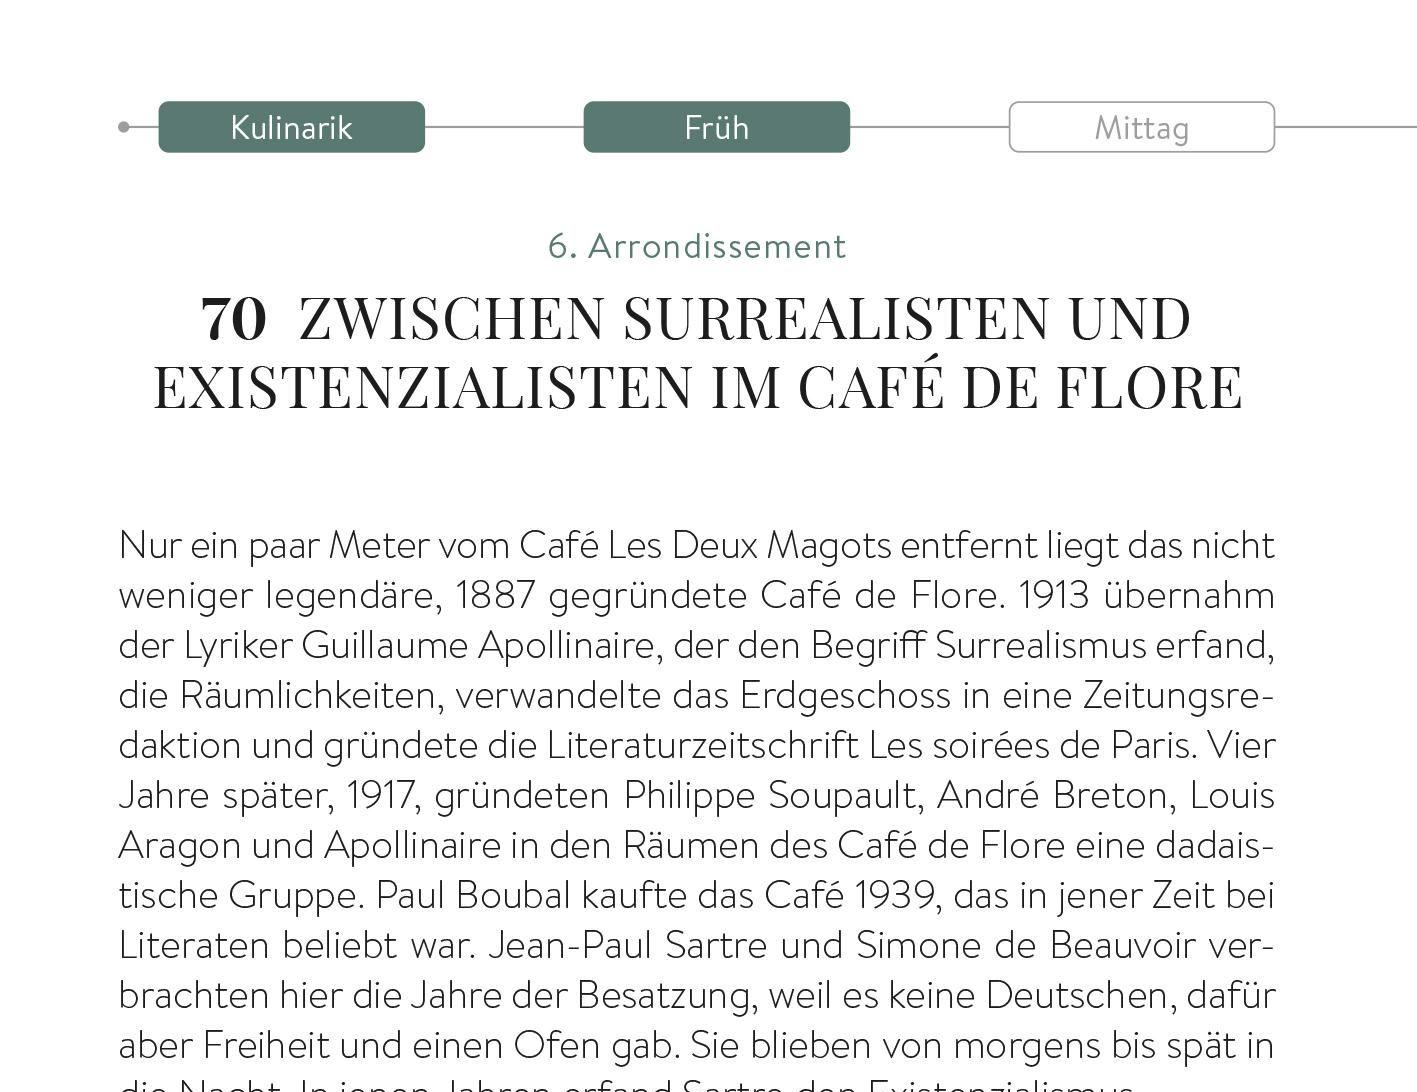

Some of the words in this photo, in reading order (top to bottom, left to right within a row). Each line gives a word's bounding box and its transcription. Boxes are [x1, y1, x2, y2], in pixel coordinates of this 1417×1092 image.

[232, 114, 353, 140] Kulinarik
[686, 114, 749, 140] Früh
[1095, 114, 1188, 147] Mittag
[548, 232, 577, 259] 6.
[587, 232, 847, 259] Arrondissement
[201, 296, 267, 341] 70
[299, 296, 605, 341] ZWISCHEN
[624, 296, 1051, 341] SURREALISTEN
[1067, 297, 1190, 341] UND
[153, 365, 693, 410] EXISTENZIALISTEN
[711, 366, 781, 409] IM
[799, 352, 944, 410] CAFÉ
[962, 366, 1038, 409] DE
[1056, 365, 1242, 410] FLORE
[121, 529, 183, 559] Nur
[191, 531, 237, 559] ein
[250, 538, 321, 568] paar
[329, 529, 431, 559] Meter
[438, 538, 509, 559] vom
[520, 529, 599, 559] Café
[610, 529, 662, 559] Les
[674, 529, 758, 559] Deux
[767, 529, 892, 568] Magots
[901, 529, 1039, 559] entfernt
[1048, 529, 1120, 568] liegt
[1128, 529, 1183, 559] das
[1193, 529, 1276, 559] nicht
[118, 581, 254, 618] weniger
[267, 579, 442, 618] legendäre,
[456, 579, 536, 609] 1887
[549, 579, 747, 618] gegründete
[761, 579, 841, 609] Café
[855, 579, 896, 609] de
[913, 579, 1005, 609] Flore.
[1019, 579, 1089, 610] 1913
[1105, 579, 1274, 609] übernahm
[119, 629, 175, 659] der
[186, 629, 294, 668] Lyriker
[302, 629, 468, 659] Guillaume
[477, 629, 663, 668] Apollinaire,
[674, 629, 730, 659] der
[738, 629, 799, 659] den
[813, 629, 929, 668] Begriff
[936, 629, 1147, 659] Surrealismus
[1156, 629, 1274, 666] erfand,
[119, 679, 168, 709] die
[182, 679, 444, 716] Räumlichkeiten,
[455, 679, 661, 709] verwandelte
[673, 679, 729, 709] das
[742, 679, 951, 718] Erdgeschoss
[963, 681, 989, 709] in
[1003, 681, 1072, 709] eine
[1083, 679, 1274, 718] Zeitungsre-
[118, 779, 209, 809] Jahre
[223, 781, 334, 818] später,
[347, 779, 421, 816] 1917,
[435, 779, 608, 818] gründeten
[626, 779, 755, 818] Philippe
[769, 779, 924, 818] Soupault,
[936, 779, 1039, 809] André
[1055, 779, 1176, 816] Breton,
[1192, 779, 1275, 809] Louis
